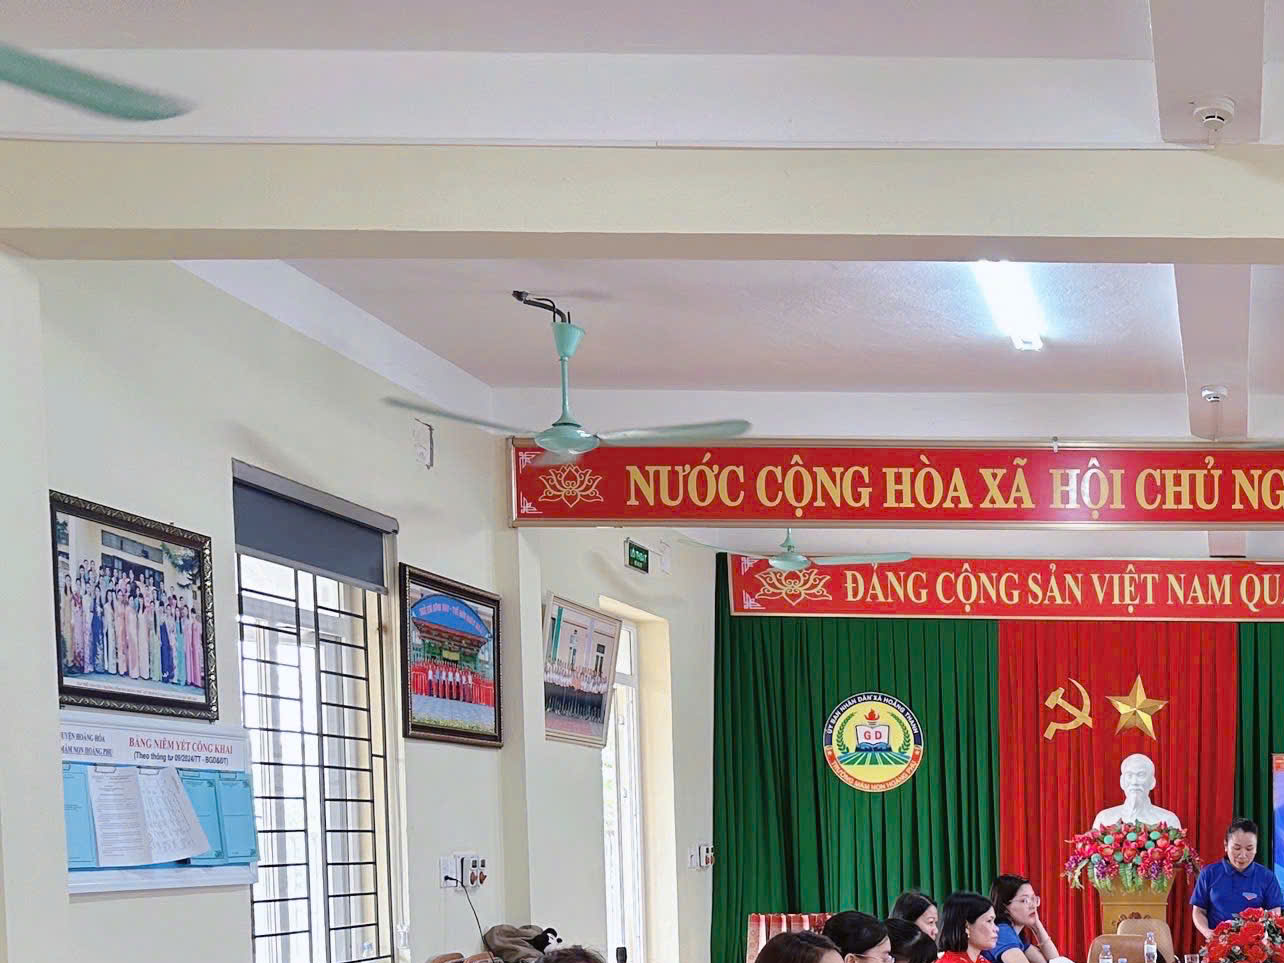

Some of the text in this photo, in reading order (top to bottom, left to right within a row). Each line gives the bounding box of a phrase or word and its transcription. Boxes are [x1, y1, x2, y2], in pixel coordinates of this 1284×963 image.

[626, 452, 745, 507] NƯỚC
[756, 454, 872, 518] CỘNG
[881, 454, 974, 508] HÒA
[979, 458, 1035, 508] XÃ
[1050, 457, 1126, 520] HỘI
[1136, 456, 1222, 510] CHỦ
[844, 561, 928, 603] ĐẢNG
[935, 563, 1019, 613] CỘNG
[1028, 564, 1083, 604] SẢN
[1090, 564, 1159, 614] VIỆT
[1167, 573, 1232, 605] NAM
[864, 731, 882, 740] G D
